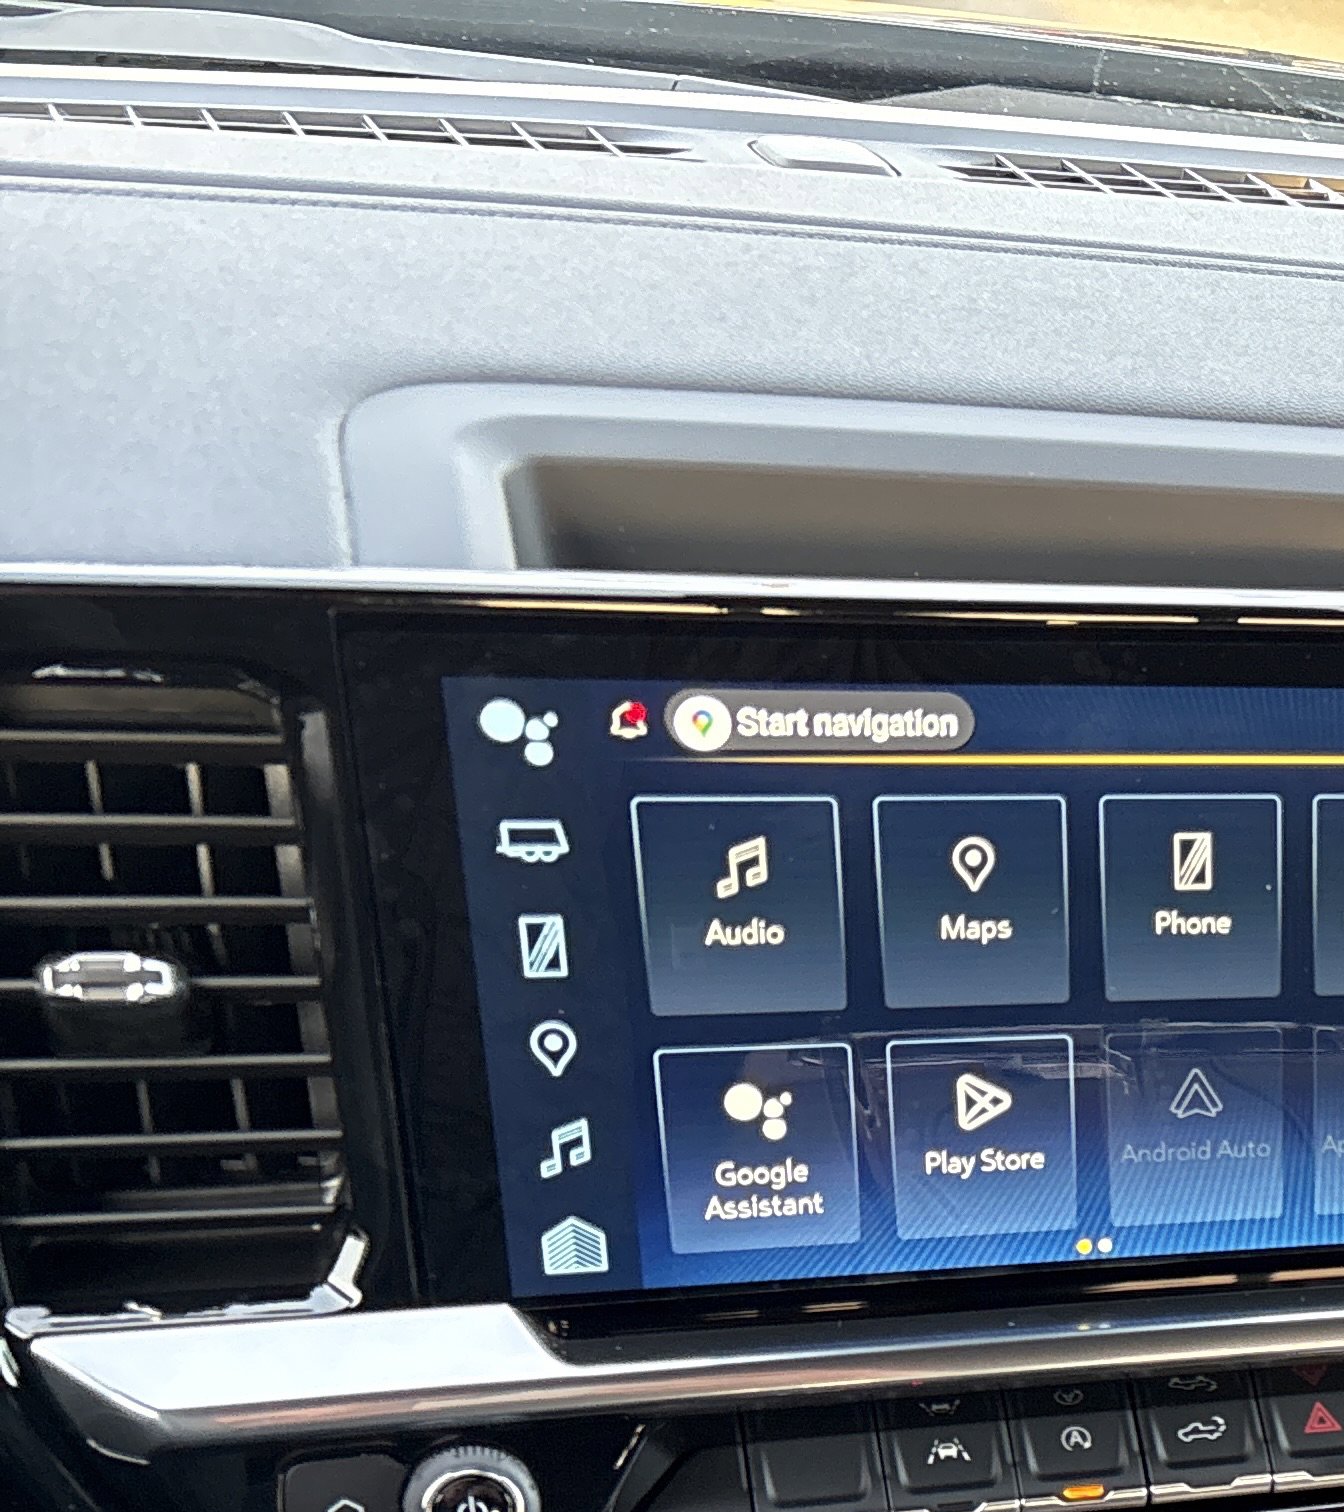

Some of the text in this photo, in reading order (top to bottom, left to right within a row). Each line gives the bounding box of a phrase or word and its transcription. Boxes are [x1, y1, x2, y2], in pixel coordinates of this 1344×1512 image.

[736, 705, 958, 743] Start navigation
[704, 916, 785, 947] Audio
[939, 912, 1014, 945] Maps
[1154, 908, 1233, 936] Phone
[924, 1147, 1046, 1180] Play Store
[1121, 1139, 1272, 1164] Android Auto
[714, 1156, 810, 1191] Google
[704, 1192, 825, 1222] Assistant
